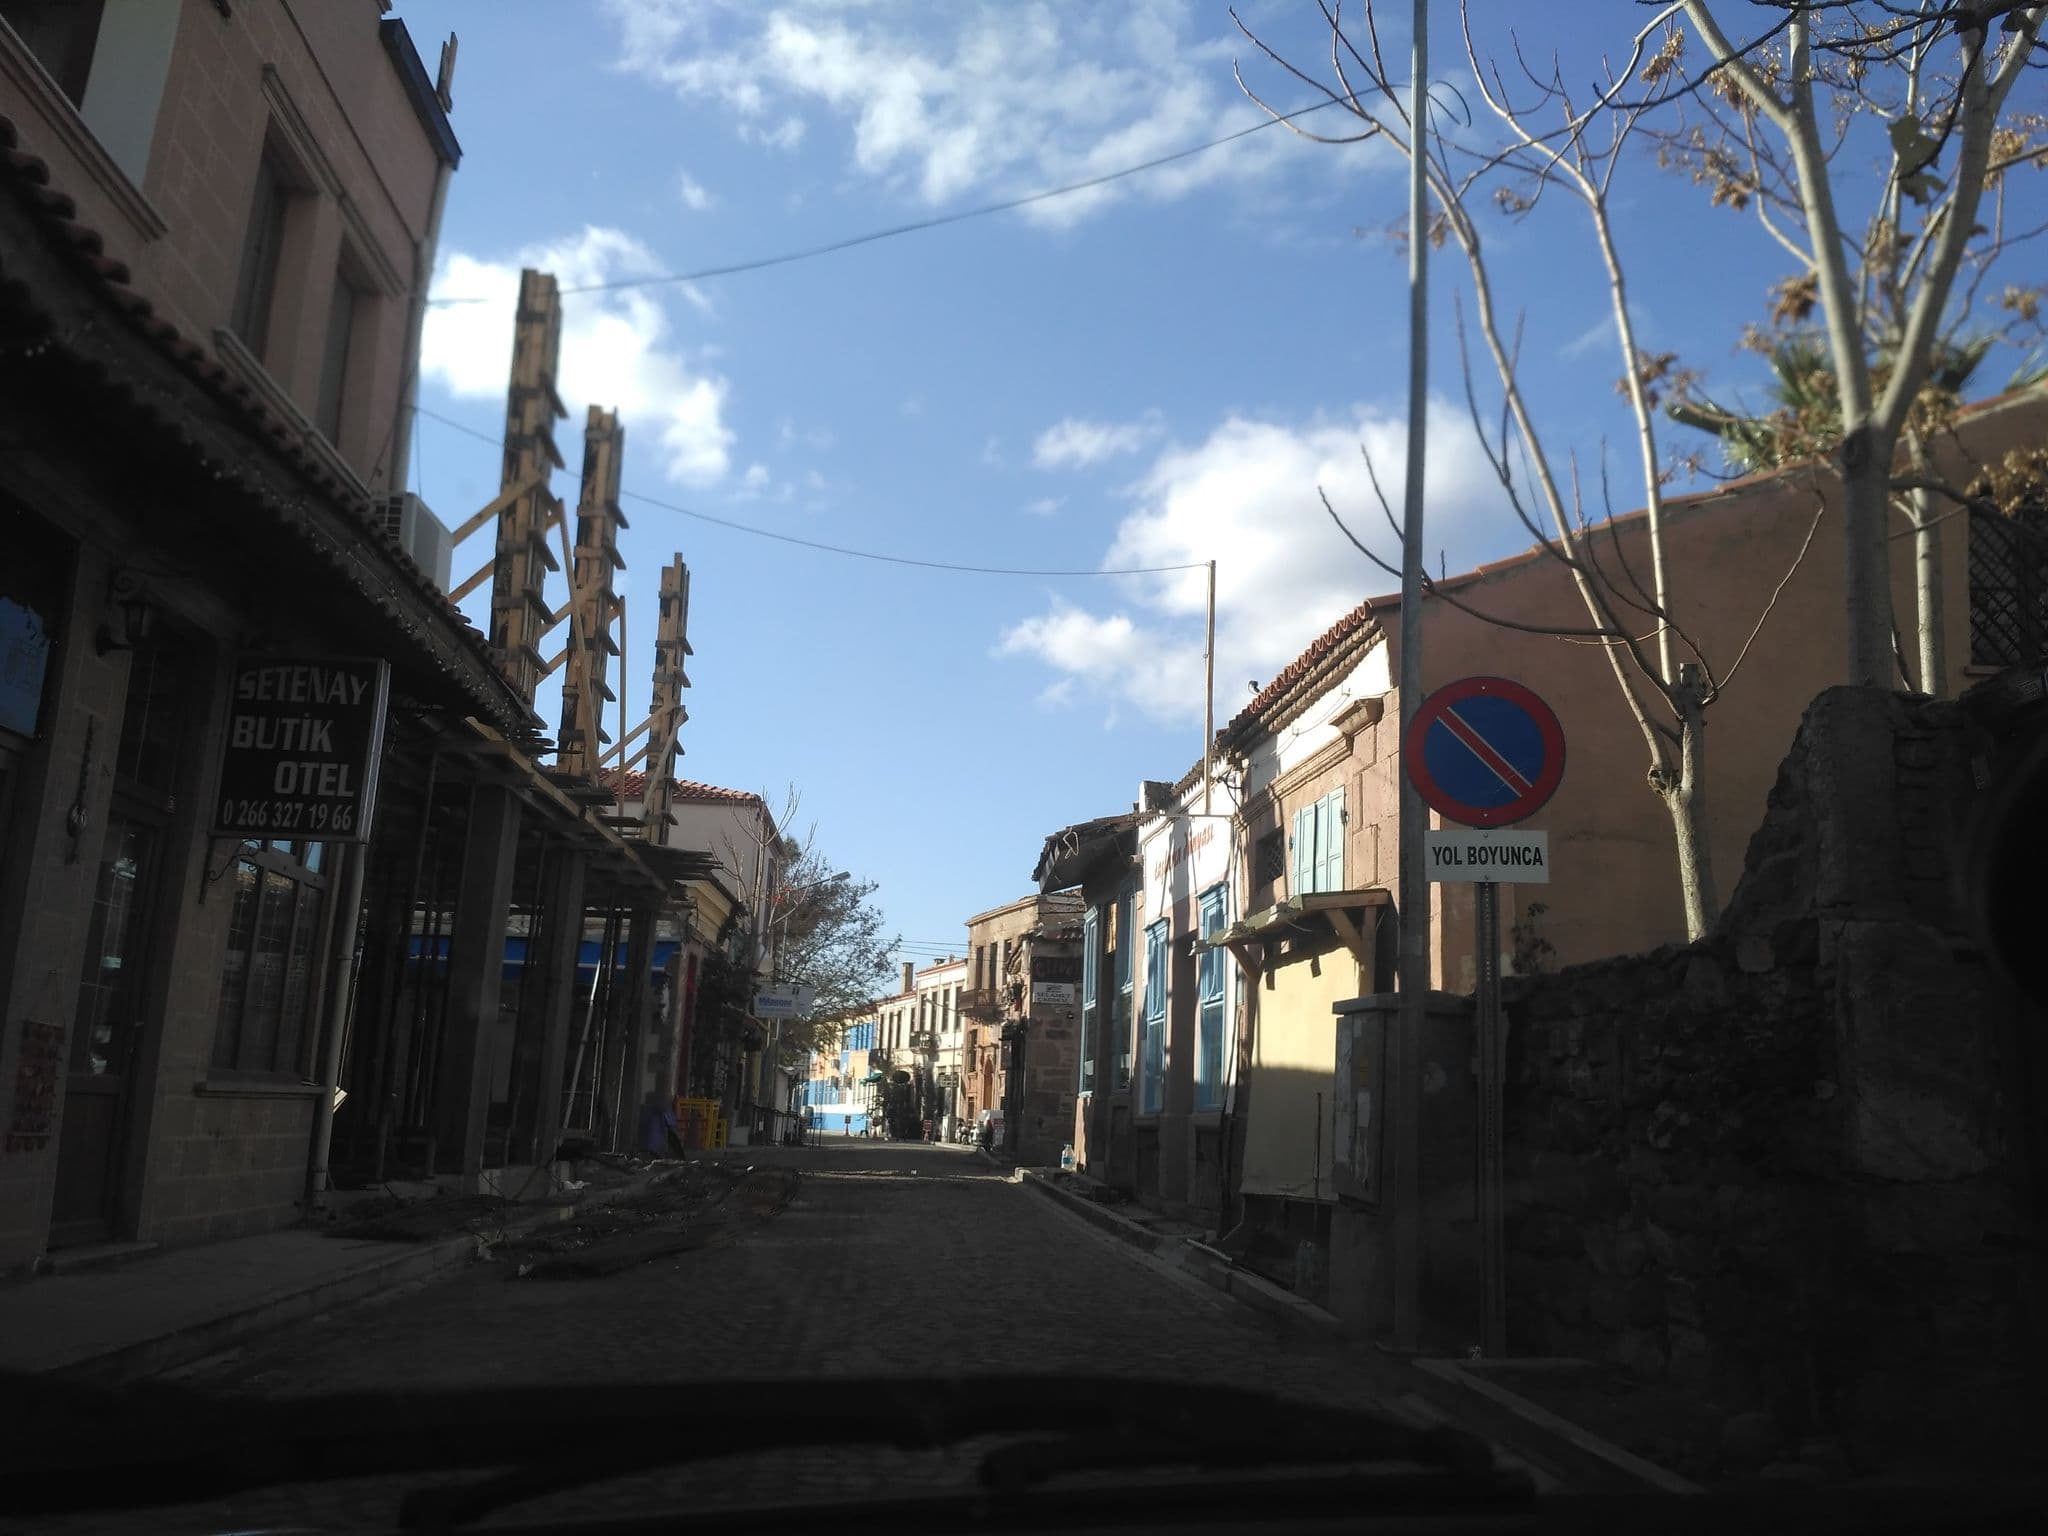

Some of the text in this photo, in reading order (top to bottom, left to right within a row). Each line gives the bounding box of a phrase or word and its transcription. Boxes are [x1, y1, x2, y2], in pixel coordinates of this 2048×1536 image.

[237, 665, 369, 705] SETENAY
[231, 712, 335, 753] BUTİK
[273, 760, 355, 798] OTEL
[223, 799, 353, 831] 0 266 327 19 66
[1432, 846, 1544, 866] YOL BOYUNCA
